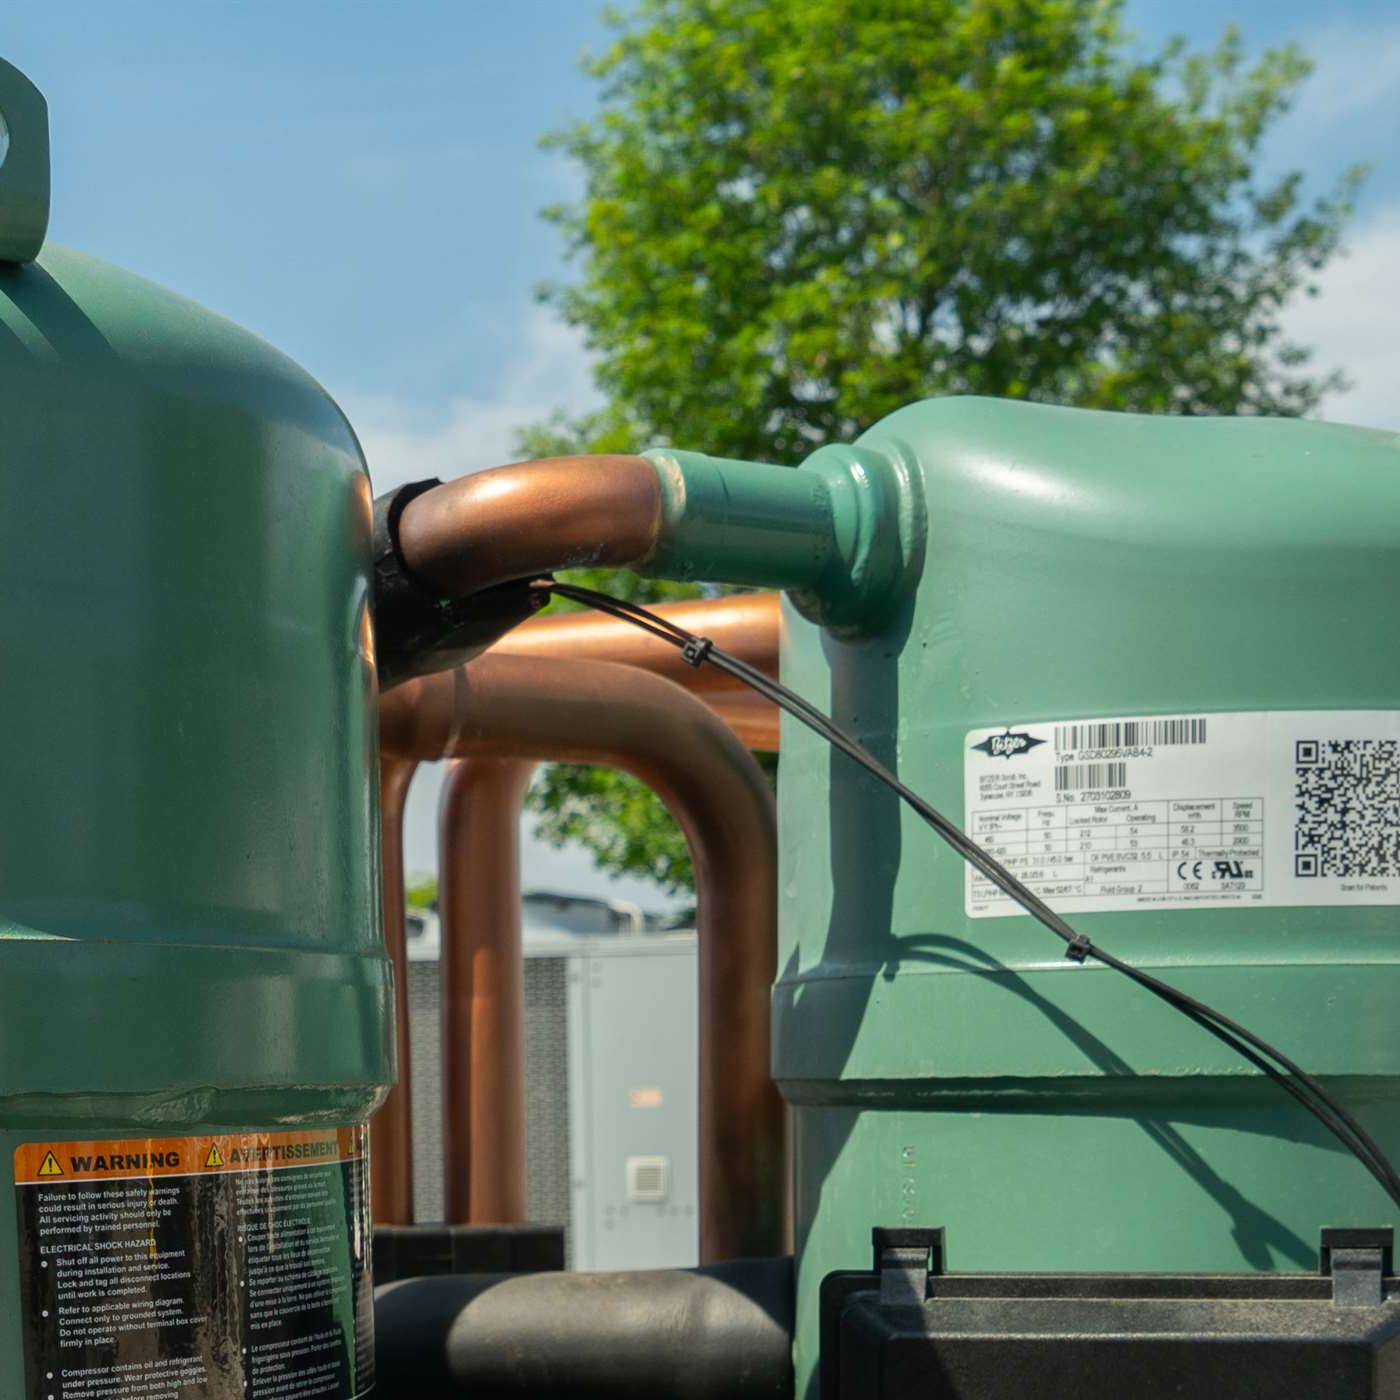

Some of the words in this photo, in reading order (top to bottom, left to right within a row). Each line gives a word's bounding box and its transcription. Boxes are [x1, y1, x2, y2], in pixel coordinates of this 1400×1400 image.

[1056, 752, 1074, 764] Type
[1173, 803, 1215, 812] Displacement
[1126, 814, 1156, 823] Operating
[1230, 848, 1259, 857] Protected
[230, 1143, 338, 1164] AVERTISSEMENT
[70, 1151, 180, 1173] WARNING
[38, 1192, 66, 1201] Failure
[78, 1192, 101, 1200] follow
[126, 1190, 147, 1198] safety
[39, 1205, 61, 1213] could
[64, 1203, 86, 1211] result
[98, 1201, 125, 1209] serious
[127, 1200, 147, 1208] injury
[40, 1216, 50, 1224] All
[53, 1214, 88, 1223] servicing
[91, 1212, 117, 1221] activity
[120, 1210, 144, 1218] should
[40, 1224, 81, 1236] performed
[83, 1224, 93, 1233] by
[95, 1223, 121, 1232] trained
[40, 1244, 92, 1254] ELECTRICAL
[95, 1241, 123, 1250] SHOCK
[125, 1239, 156, 1248] HAZARD
[56, 1258, 75, 1266] Shut
[77, 1257, 88, 1265] off
[89, 1256, 98, 1264] all
[101, 1255, 123, 1265] power
[135, 1252, 148, 1260] this
[57, 1268, 83, 1278] during
[85, 1266, 126, 1275] installation
[128, 1264, 141, 1272] and
[58, 1280, 77, 1289] Lock
[79, 1279, 93, 1287] and
[95, 1278, 107, 1287] tag
[110, 1277, 118, 1285] all
[120, 1274, 159, 1284] disconnect
[161, 1271, 191, 1280] locations
[58, 1291, 76, 1300] until
[78, 1289, 97, 1298] work
[62, 1365, 109, 1379] Compressor
[111, 1363, 142, 1373] contains
[144, 1361, 153, 1369] oil
[155, 1359, 168, 1367] and
[63, 1380, 85, 1389] under
[125, 1374, 142, 1382] Wear
[145, 1370, 178, 1381] protective
